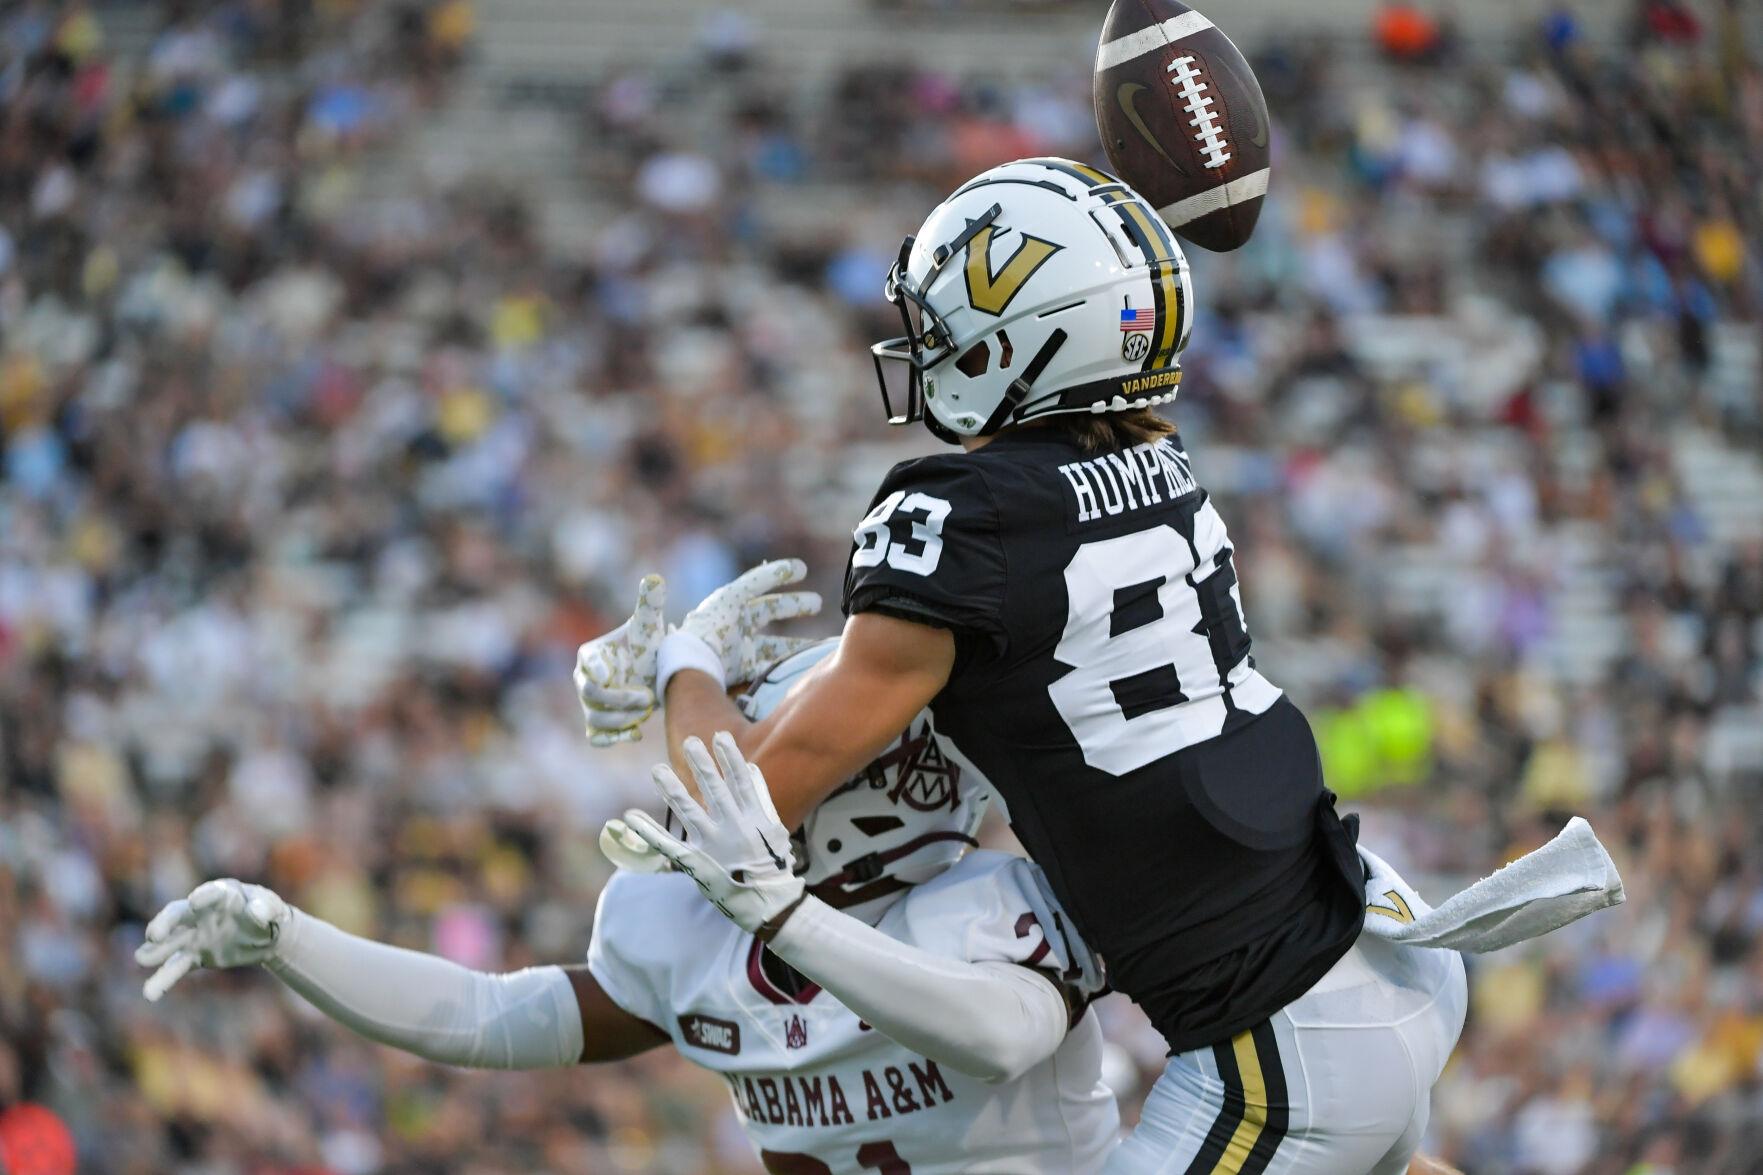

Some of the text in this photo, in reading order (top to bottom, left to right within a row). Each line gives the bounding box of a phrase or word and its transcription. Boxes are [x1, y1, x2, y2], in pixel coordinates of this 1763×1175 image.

[1121, 371, 1183, 395] VANDERB
[852, 490, 953, 577] 83
[700, 1022, 733, 1049] SWAC
[862, 1058, 954, 1121] A&M
